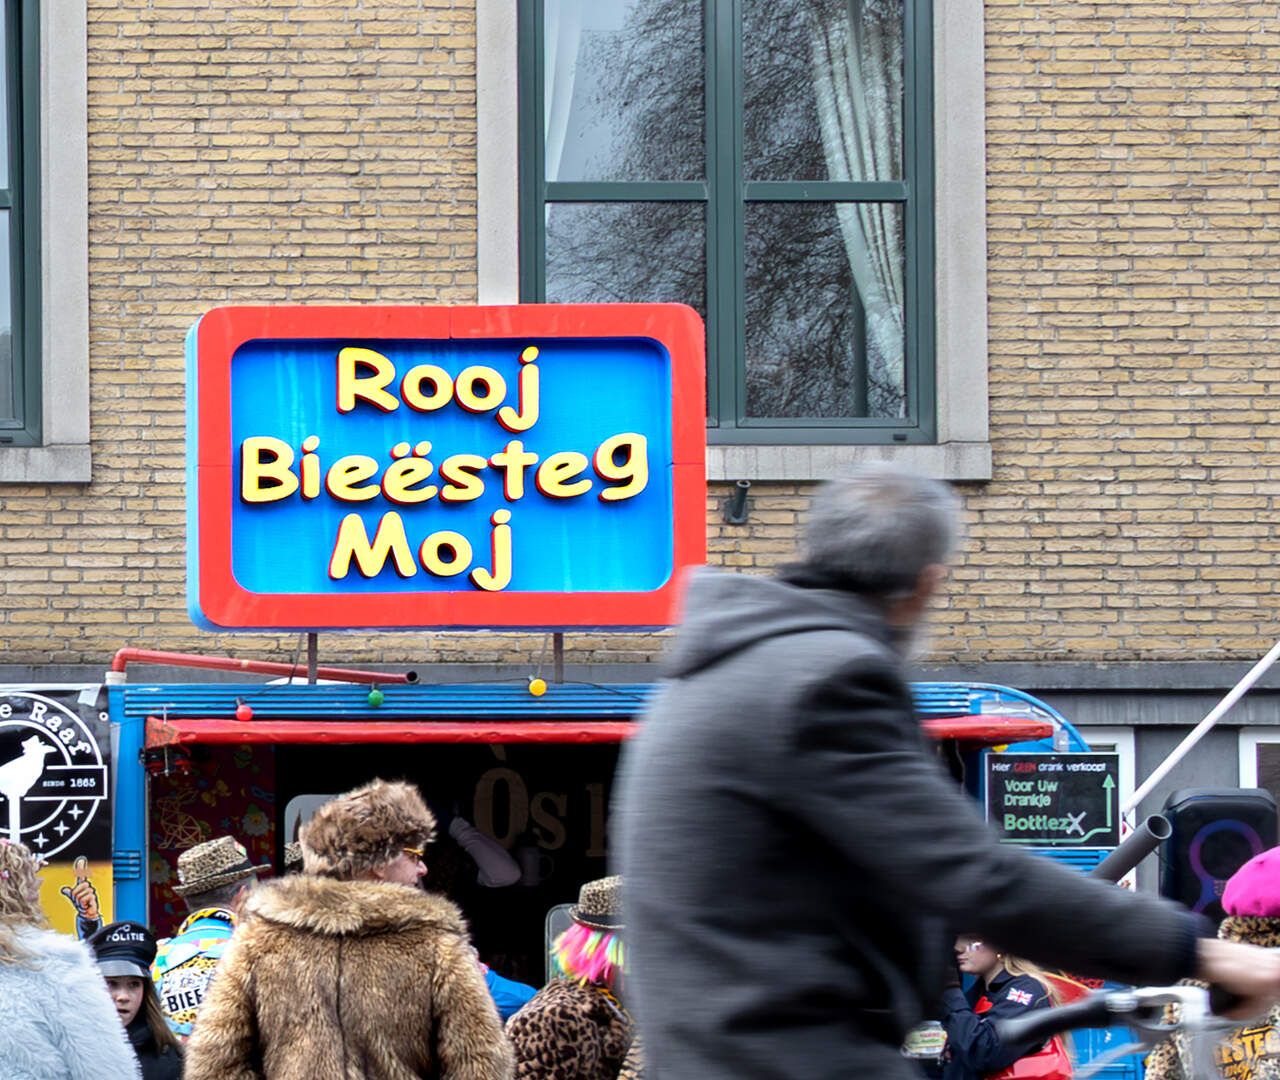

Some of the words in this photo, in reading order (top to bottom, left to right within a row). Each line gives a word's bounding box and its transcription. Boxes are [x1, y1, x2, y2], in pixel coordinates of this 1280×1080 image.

[336, 346, 540, 433] Rooj
[241, 433, 650, 504] Bieësteg
[329, 508, 513, 592] Moj
[29, 701, 93, 756] Raaf
[70, 778, 96, 788] 1865
[991, 762, 1011, 772] Hier
[1038, 762, 1064, 772] drank
[1004, 793, 1052, 808] Drankje
[1005, 780, 1035, 792] Voor
[1037, 780, 1059, 792] Uw
